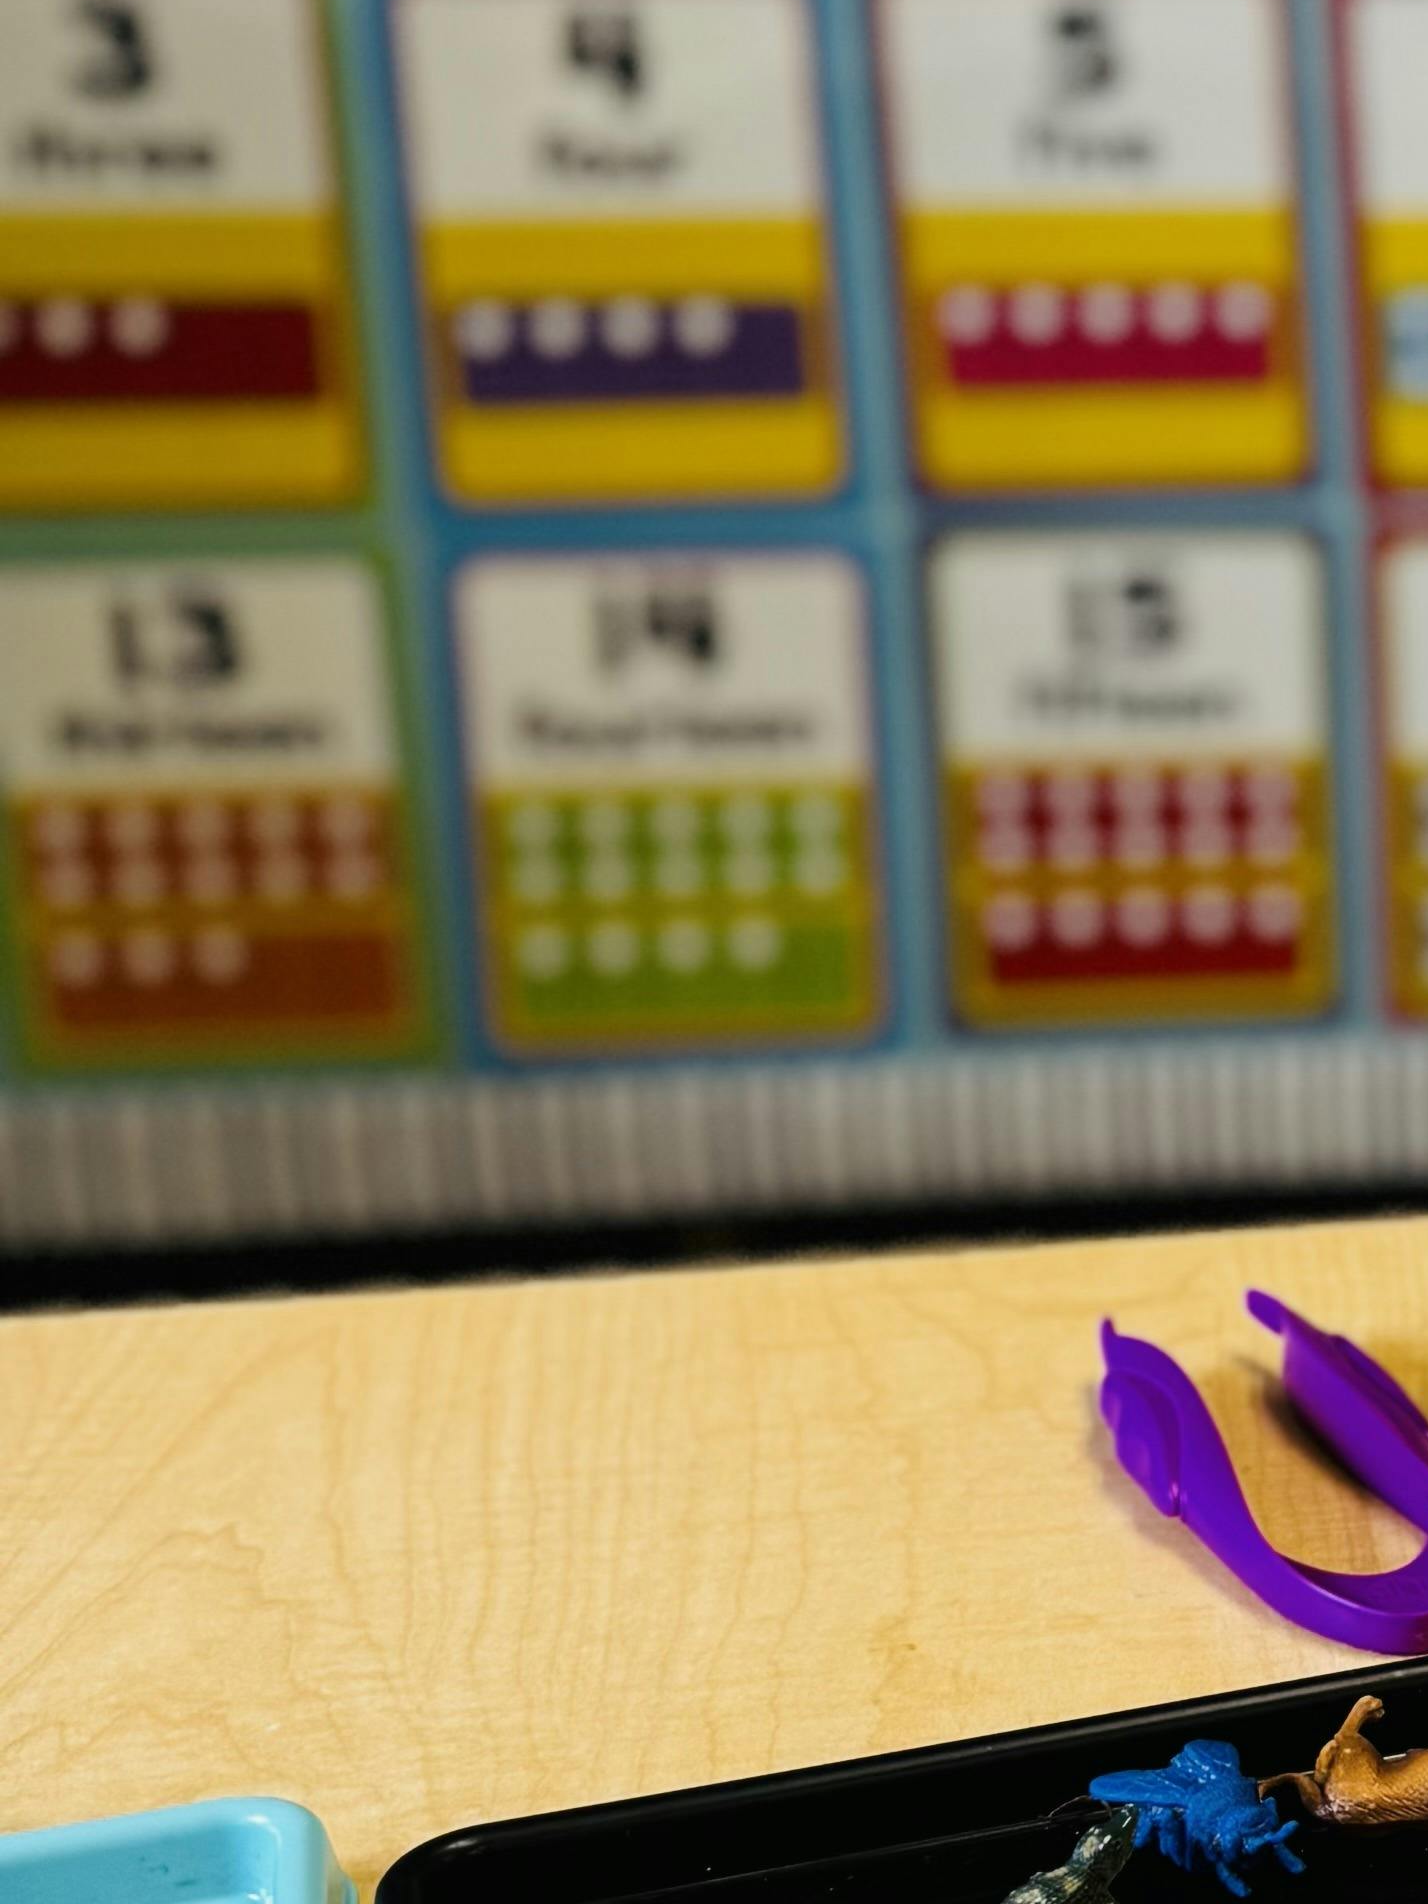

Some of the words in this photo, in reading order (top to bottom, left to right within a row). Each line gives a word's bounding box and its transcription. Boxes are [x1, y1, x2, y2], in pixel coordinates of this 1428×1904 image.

[564, 2, 650, 102] 4
[1052, 0, 1122, 100] 5
[110, 584, 242, 688] 13
[590, 588, 718, 676] 14
